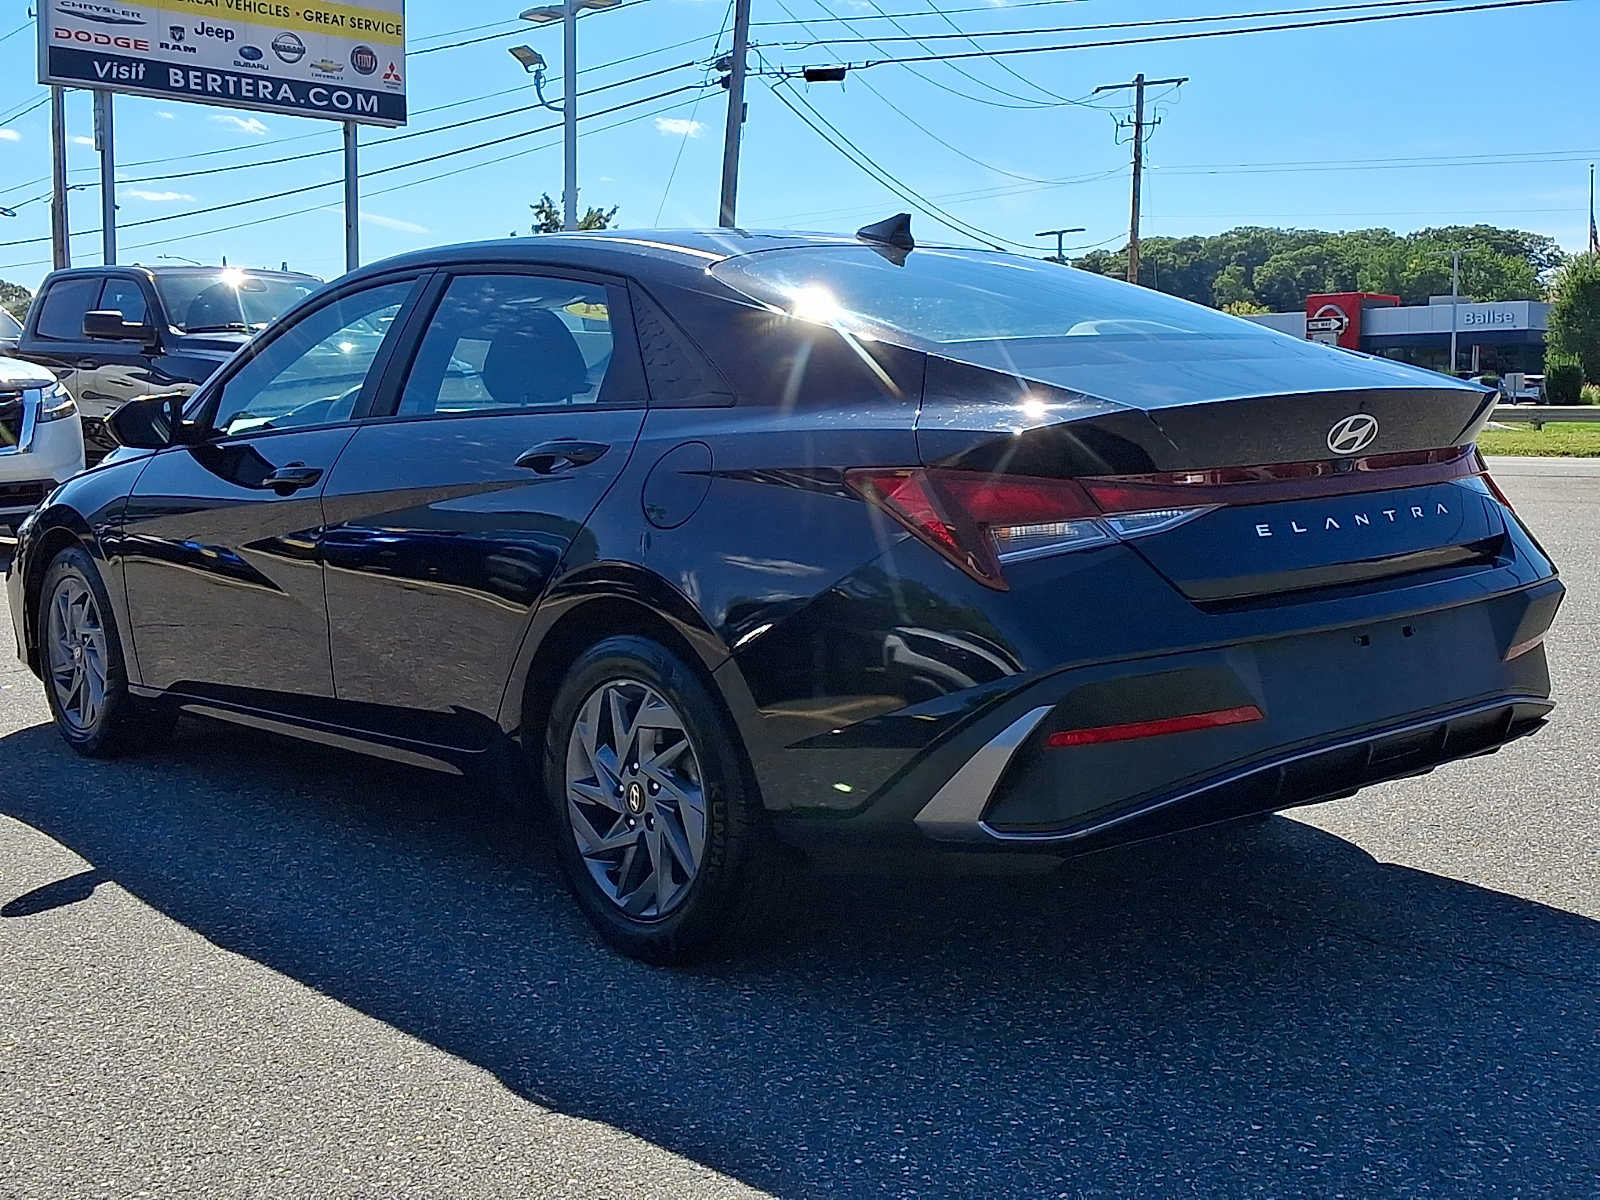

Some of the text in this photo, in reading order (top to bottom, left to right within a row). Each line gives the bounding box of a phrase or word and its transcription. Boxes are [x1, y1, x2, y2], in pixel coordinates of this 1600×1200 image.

[60, 0, 141, 18] CHRYSLER
[226, 0, 402, 36] VEHICLES GREAT SERVICE
[54, 27, 150, 52] DODGE
[194, 21, 235, 42] Jeep
[159, 42, 197, 54] RAM
[233, 60, 270, 71] SUBARU
[93, 60, 378, 113] Visit BERTERA.COM
[1255, 503, 1449, 537] ELANTRA
